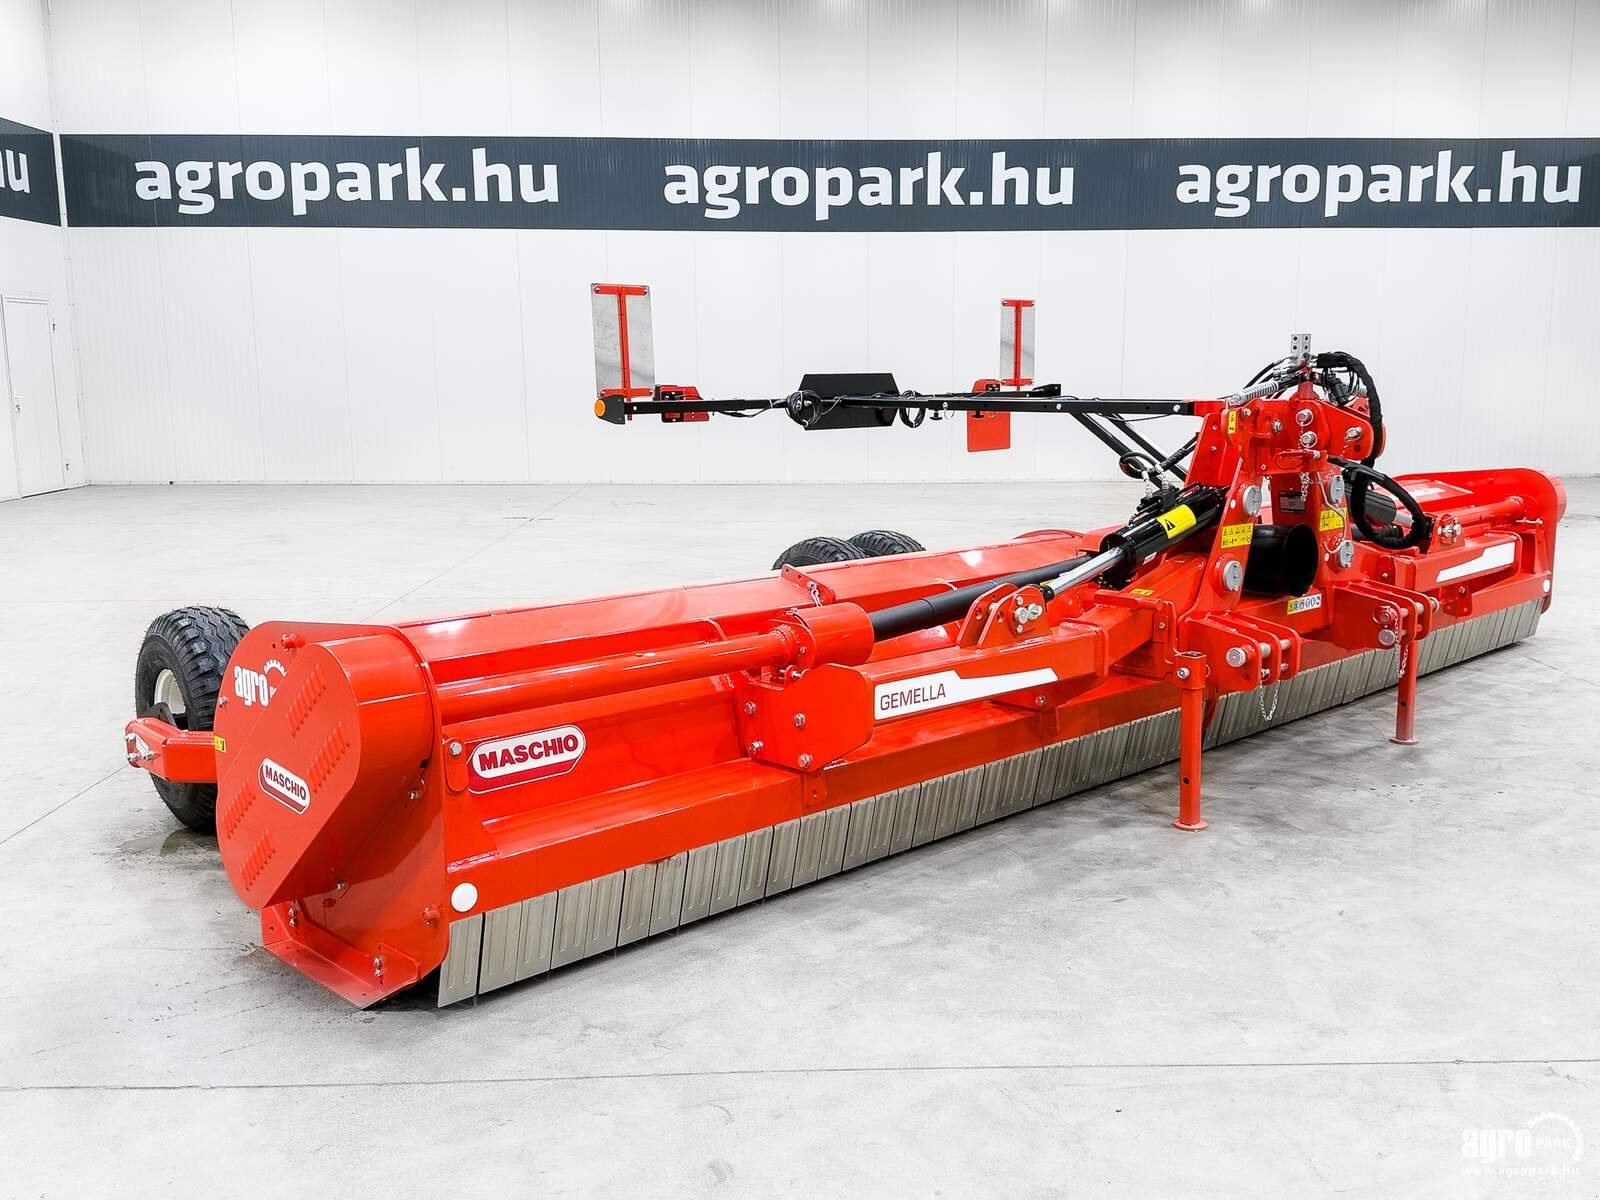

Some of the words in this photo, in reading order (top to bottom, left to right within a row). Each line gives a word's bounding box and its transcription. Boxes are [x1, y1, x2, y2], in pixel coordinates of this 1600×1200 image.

[135, 147, 560, 216] agropark.hu
[664, 151, 1075, 221] agropark.hu
[1176, 150, 1582, 218] agropark.hu
[234, 665, 269, 707] agro
[880, 683, 946, 711] GEMELLA
[478, 734, 579, 772] MASCHIO
[265, 765, 307, 801] MASCHIO
